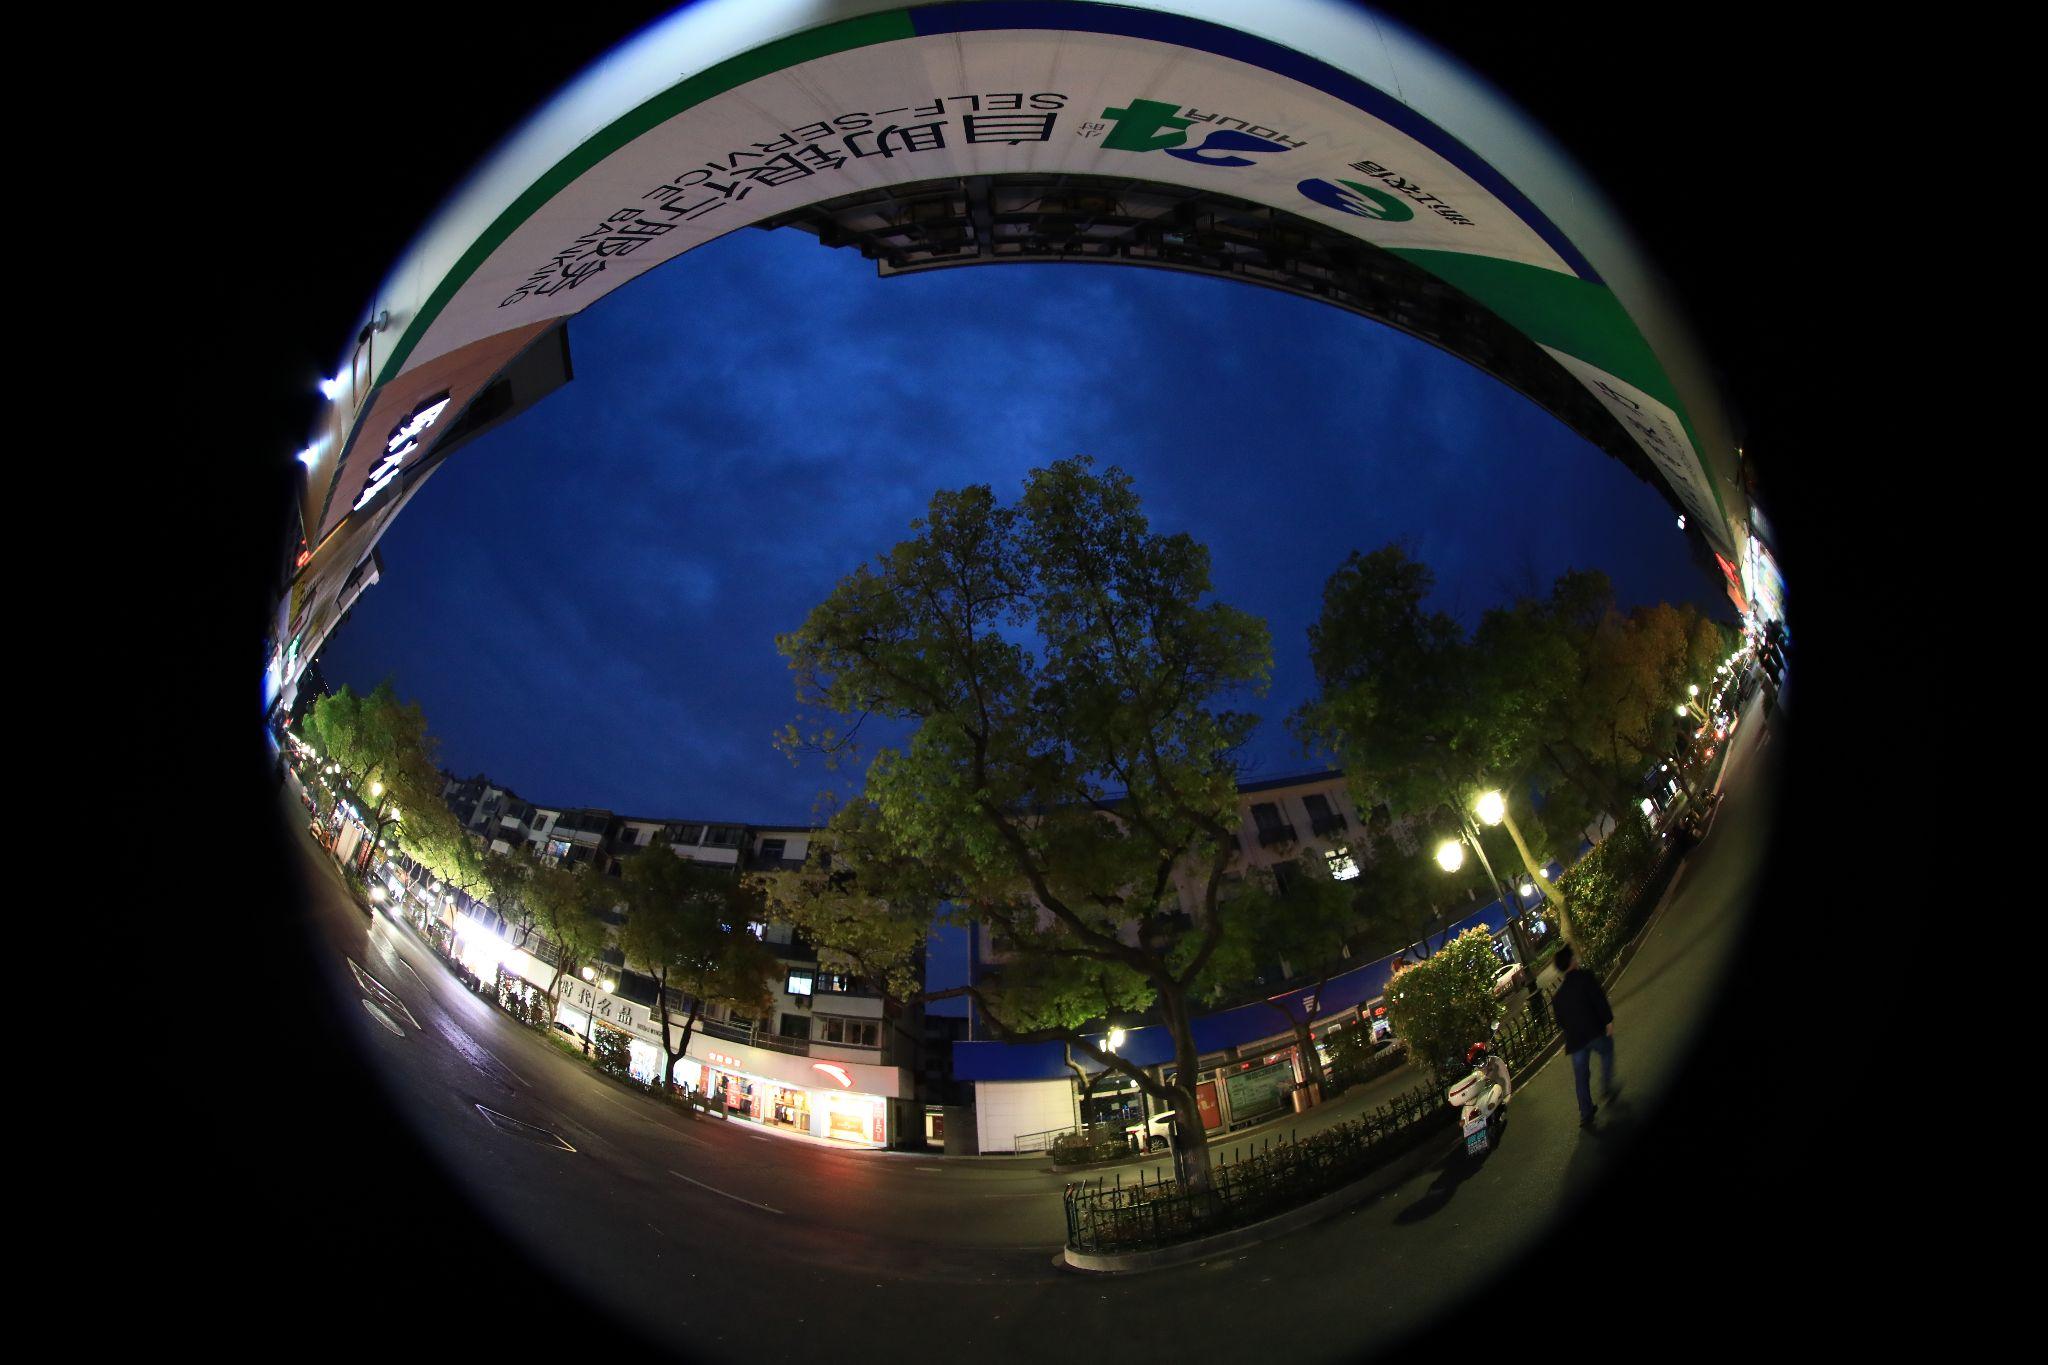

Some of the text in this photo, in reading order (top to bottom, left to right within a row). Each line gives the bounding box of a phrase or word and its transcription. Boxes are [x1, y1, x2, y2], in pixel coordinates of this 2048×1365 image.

[1100, 98, 1292, 167] 24
[533, 112, 1058, 297] 自助银行服务
[1347, 160, 1475, 227] 浙江农信
[497, 207, 645, 309] BANKING
